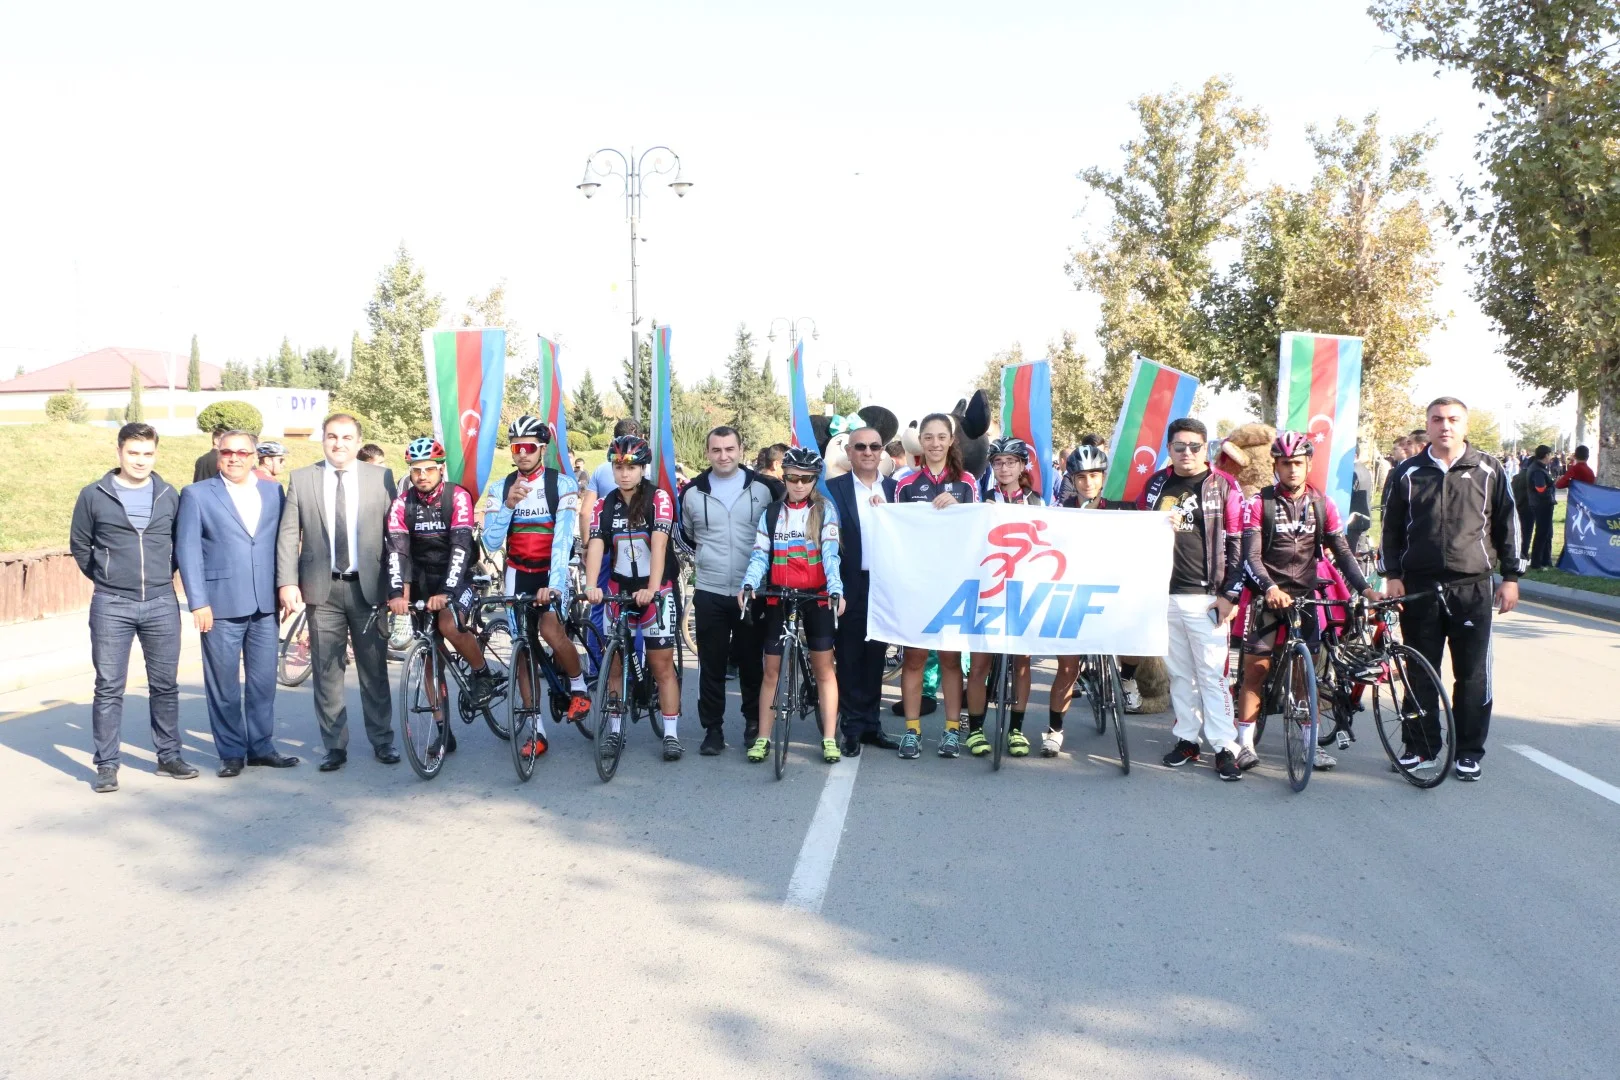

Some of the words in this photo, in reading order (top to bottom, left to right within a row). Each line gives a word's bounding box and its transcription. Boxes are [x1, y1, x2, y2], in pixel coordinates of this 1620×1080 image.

[291, 396, 316, 410] DYP
[414, 521, 446, 531] BAKU
[612, 518, 647, 530] BAU
[1276, 520, 1316, 534] BAKU
[389, 552, 402, 588] BAKU
[446, 548, 466, 588] BAKU
[664, 594, 676, 634] BAKU
[921, 579, 1120, 639] AzViF
[1219, 678, 1231, 716] AZERBAIJAN
